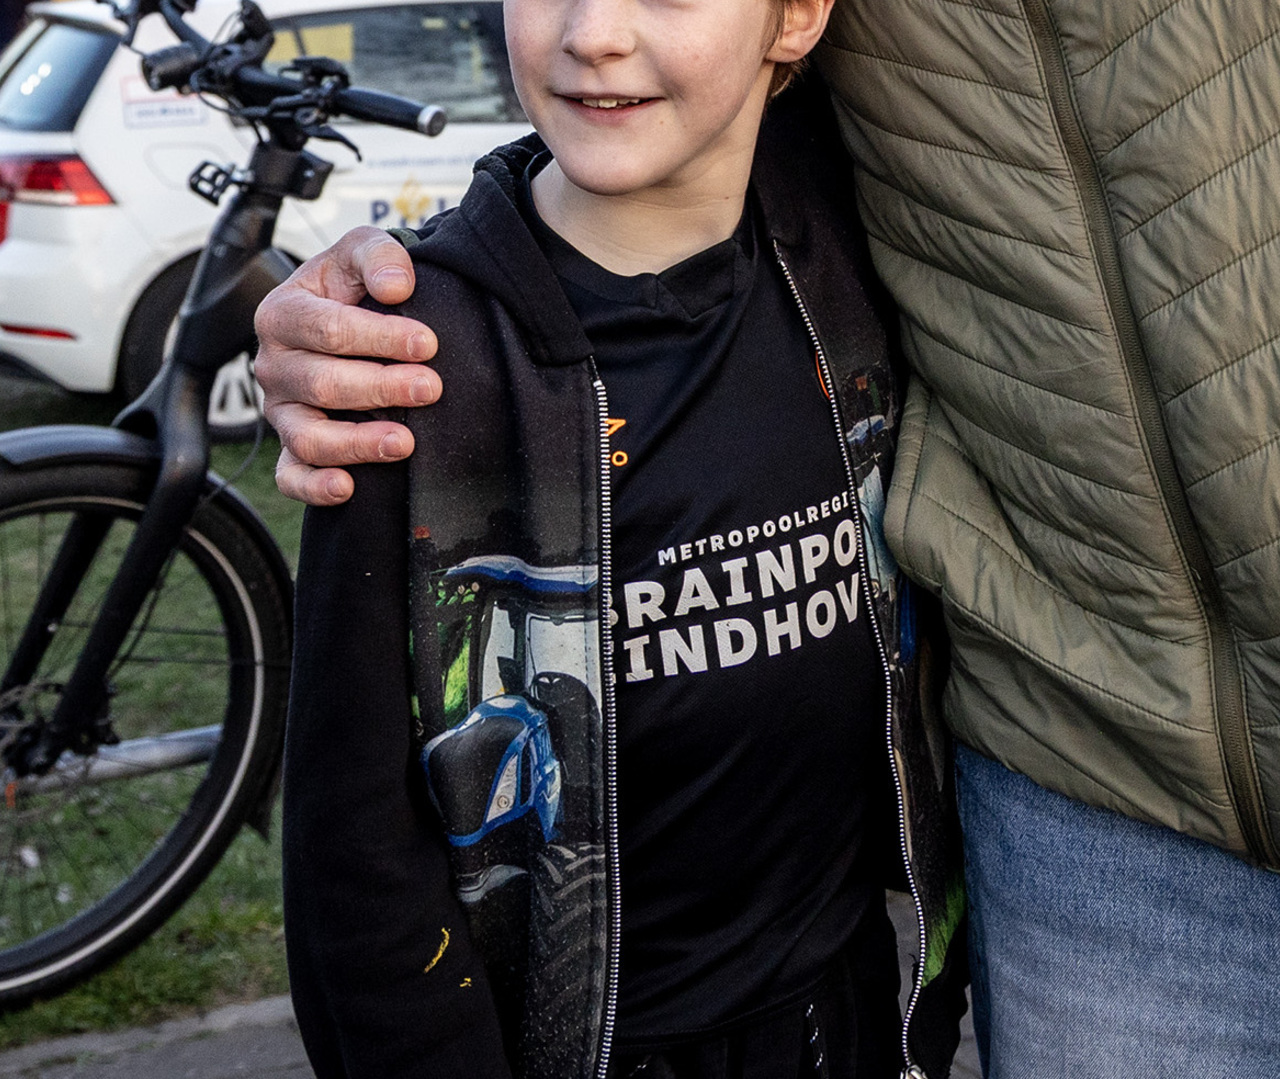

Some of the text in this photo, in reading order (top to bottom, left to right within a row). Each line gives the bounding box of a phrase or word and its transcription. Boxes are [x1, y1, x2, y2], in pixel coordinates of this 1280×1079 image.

[606, 518, 858, 629] RAINPO
[657, 490, 849, 567] METROPOOLREGI
[608, 571, 860, 684] INDHOV
